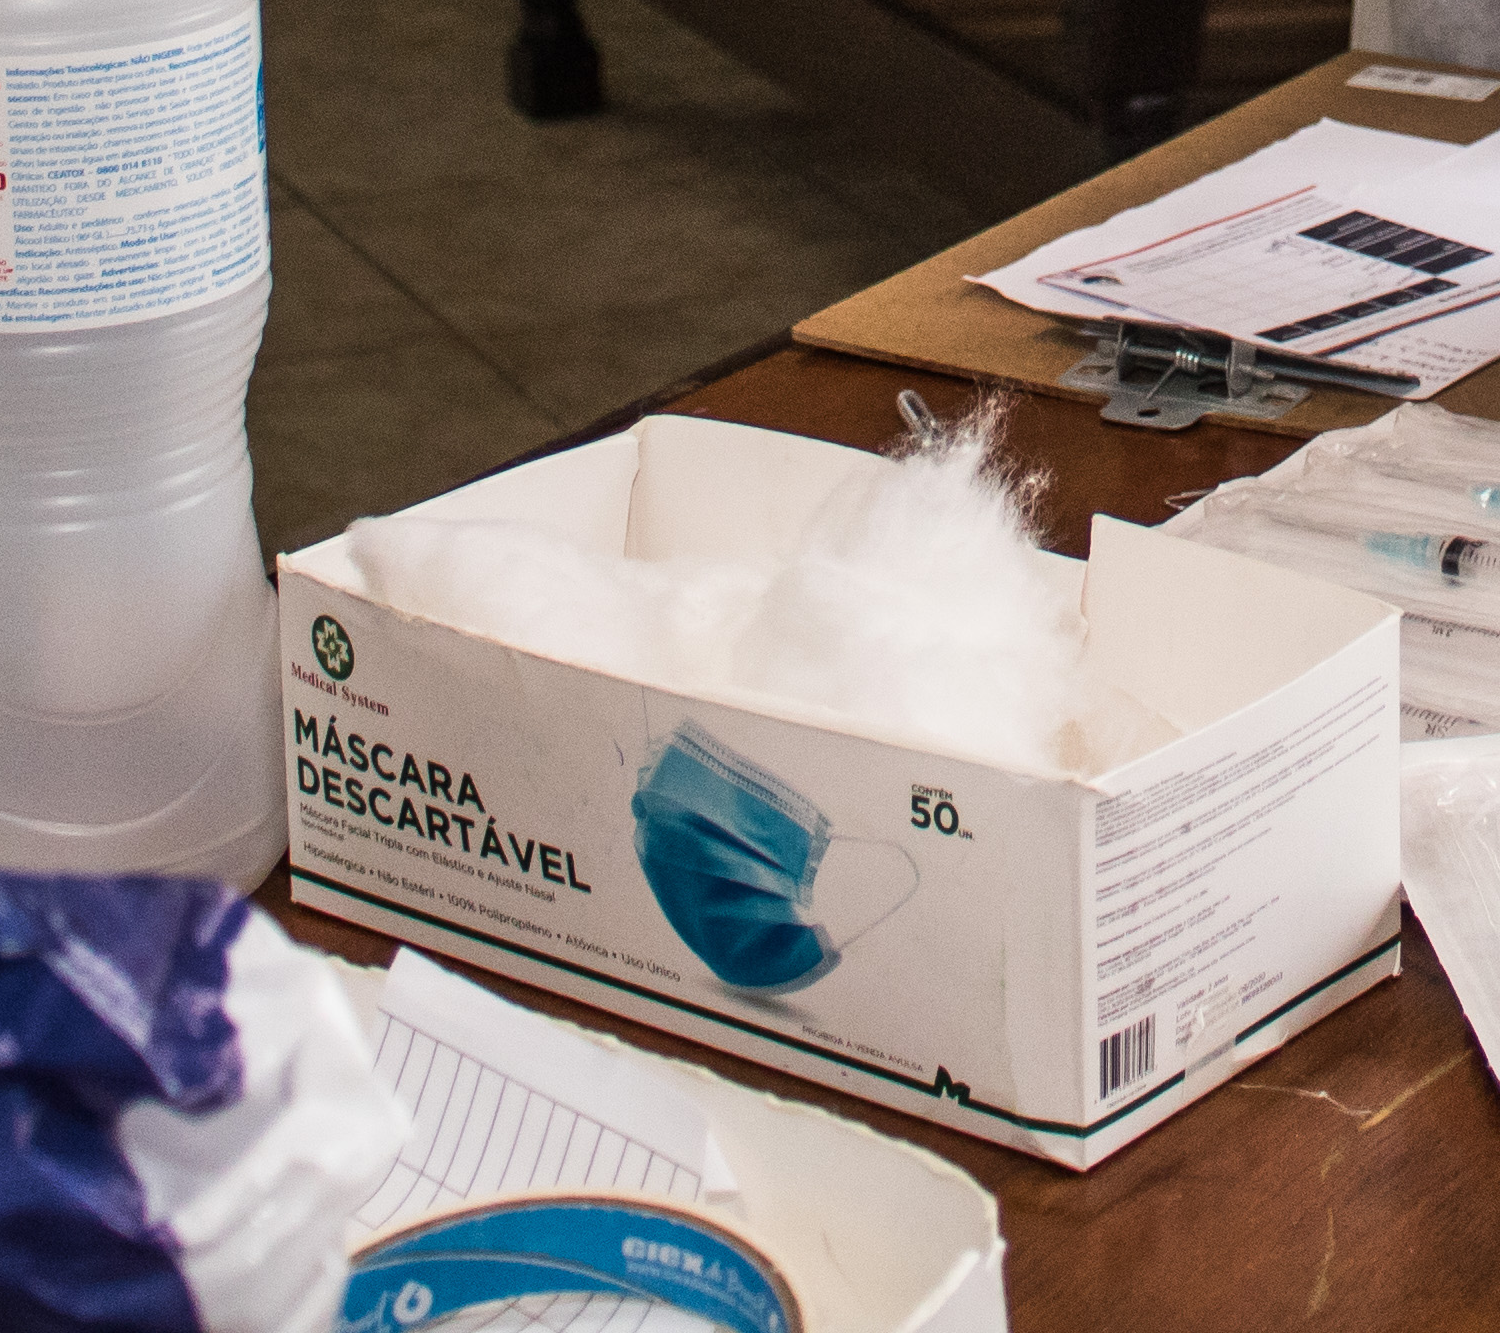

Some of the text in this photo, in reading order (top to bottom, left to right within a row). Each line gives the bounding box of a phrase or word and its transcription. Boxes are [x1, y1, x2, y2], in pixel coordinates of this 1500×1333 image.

[122, 161, 139, 171] 014
[291, 662, 390, 717] Medical System
[294, 707, 487, 814] MÁSCARA
[911, 783, 953, 801] CONTÉM
[297, 755, 592, 894] DESCARTÁVEL
[300, 802, 339, 828] Máscara
[341, 819, 371, 840] Facial
[373, 831, 403, 851] Tripla
[405, 845, 430, 860] com
[432, 851, 475, 876] Elástico
[477, 868, 485, 879] e
[488, 871, 523, 893] Ajuste
[525, 882, 556, 903] Nasal
[910, 794, 959, 836] 50
[303, 840, 367, 875] Hipoalérgica
[377, 869, 399, 887] Não
[401, 878, 436, 899] Estéril
[447, 892, 477, 913] 100%
[479, 904, 553, 939] Polipropileno
[621, 952, 644, 970] Uso
[647, 959, 681, 983] Único
